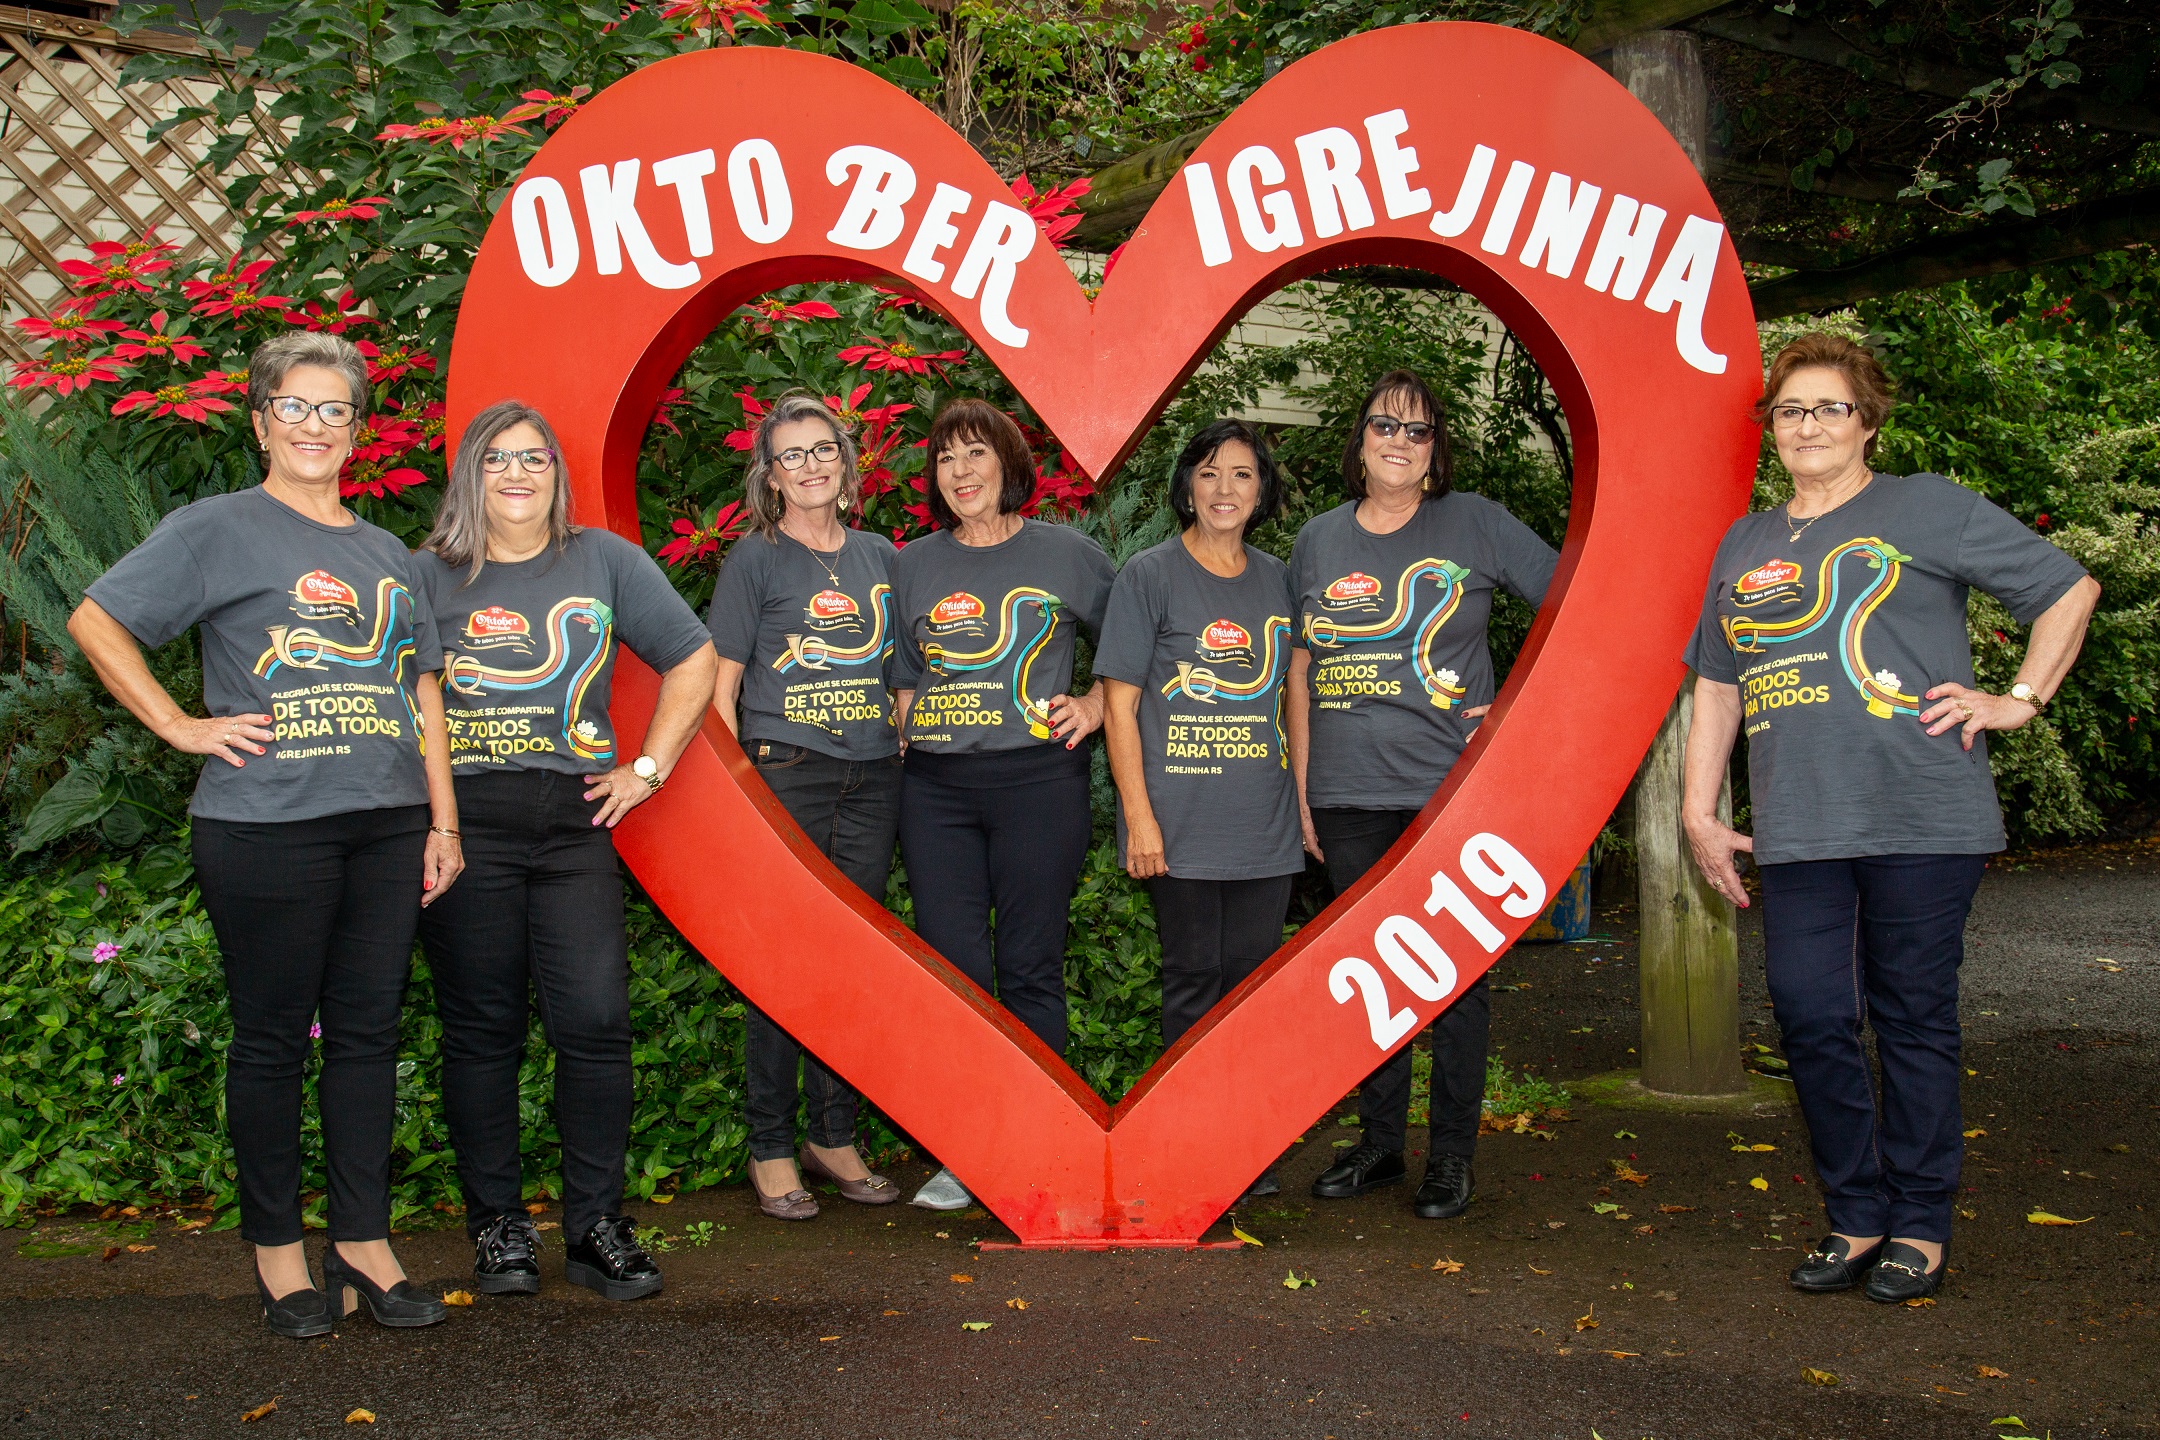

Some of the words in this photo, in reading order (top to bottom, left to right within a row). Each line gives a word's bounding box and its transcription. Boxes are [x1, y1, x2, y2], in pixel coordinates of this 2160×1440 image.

[1748, 568, 1792, 582] Oktober
[1336, 581, 1374, 592] Oktober
[940, 600, 976, 612] Oktober
[476, 614, 518, 627] Oktober
[1344, 654, 1350, 662] SE
[1750, 664, 1764, 675] QUE
[1763, 662, 1772, 672] SE
[1772, 652, 1828, 669] COMPARTILHA
[1316, 668, 1329, 680] DE
[1330, 664, 1378, 680] TODOS
[786, 683, 814, 693] ALEGRIA
[814, 680, 830, 689] QUE
[830, 680, 840, 688] SE
[841, 678, 880, 686] COMPARTILHA
[932, 685, 948, 693] QUE
[956, 682, 1004, 690] COMPARTILHA
[1315, 683, 1342, 696] PARA
[1343, 680, 1402, 696] TODOS
[1748, 668, 1800, 696] TODOS
[271, 687, 310, 699] ALEGRIA
[312, 684, 332, 694] QUE
[332, 683, 342, 692] SE
[343, 683, 395, 694] COMPARTILHA
[1760, 685, 1830, 710] TODOS
[784, 694, 807, 710] DE
[810, 689, 866, 706] TODOS
[927, 693, 981, 710] TODOS
[272, 702, 302, 720] DE
[304, 696, 377, 716] TODOS
[484, 707, 496, 716] SE
[496, 706, 555, 715] COMPARTILHA
[832, 704, 882, 722] TODOS
[912, 712, 942, 727] PARA
[944, 710, 1003, 726] TODOS
[1169, 714, 1197, 722] ALEGRIA
[1198, 716, 1214, 724] QUE
[1214, 715, 1223, 723] SE
[1224, 715, 1268, 723] COMPARTILHA
[1760, 720, 1770, 730] RS
[275, 718, 334, 741] PARA
[336, 716, 400, 738] TODOS
[468, 718, 531, 738] TODOS
[1168, 726, 1188, 740] DE
[1192, 726, 1251, 742] TODOS
[450, 737, 482, 752] ARA
[486, 736, 556, 756] TODOS
[942, 734, 952, 742] RS
[276, 747, 334, 760] IGREJINHA
[336, 745, 351, 754] RS
[1166, 742, 1210, 758] PARA
[1212, 743, 1268, 758] TODOS
[492, 756, 506, 764] RS
[1166, 766, 1210, 774] IGREJINHA
[1210, 766, 1222, 774] RS
[1328, 832, 1547, 1051] 2019
